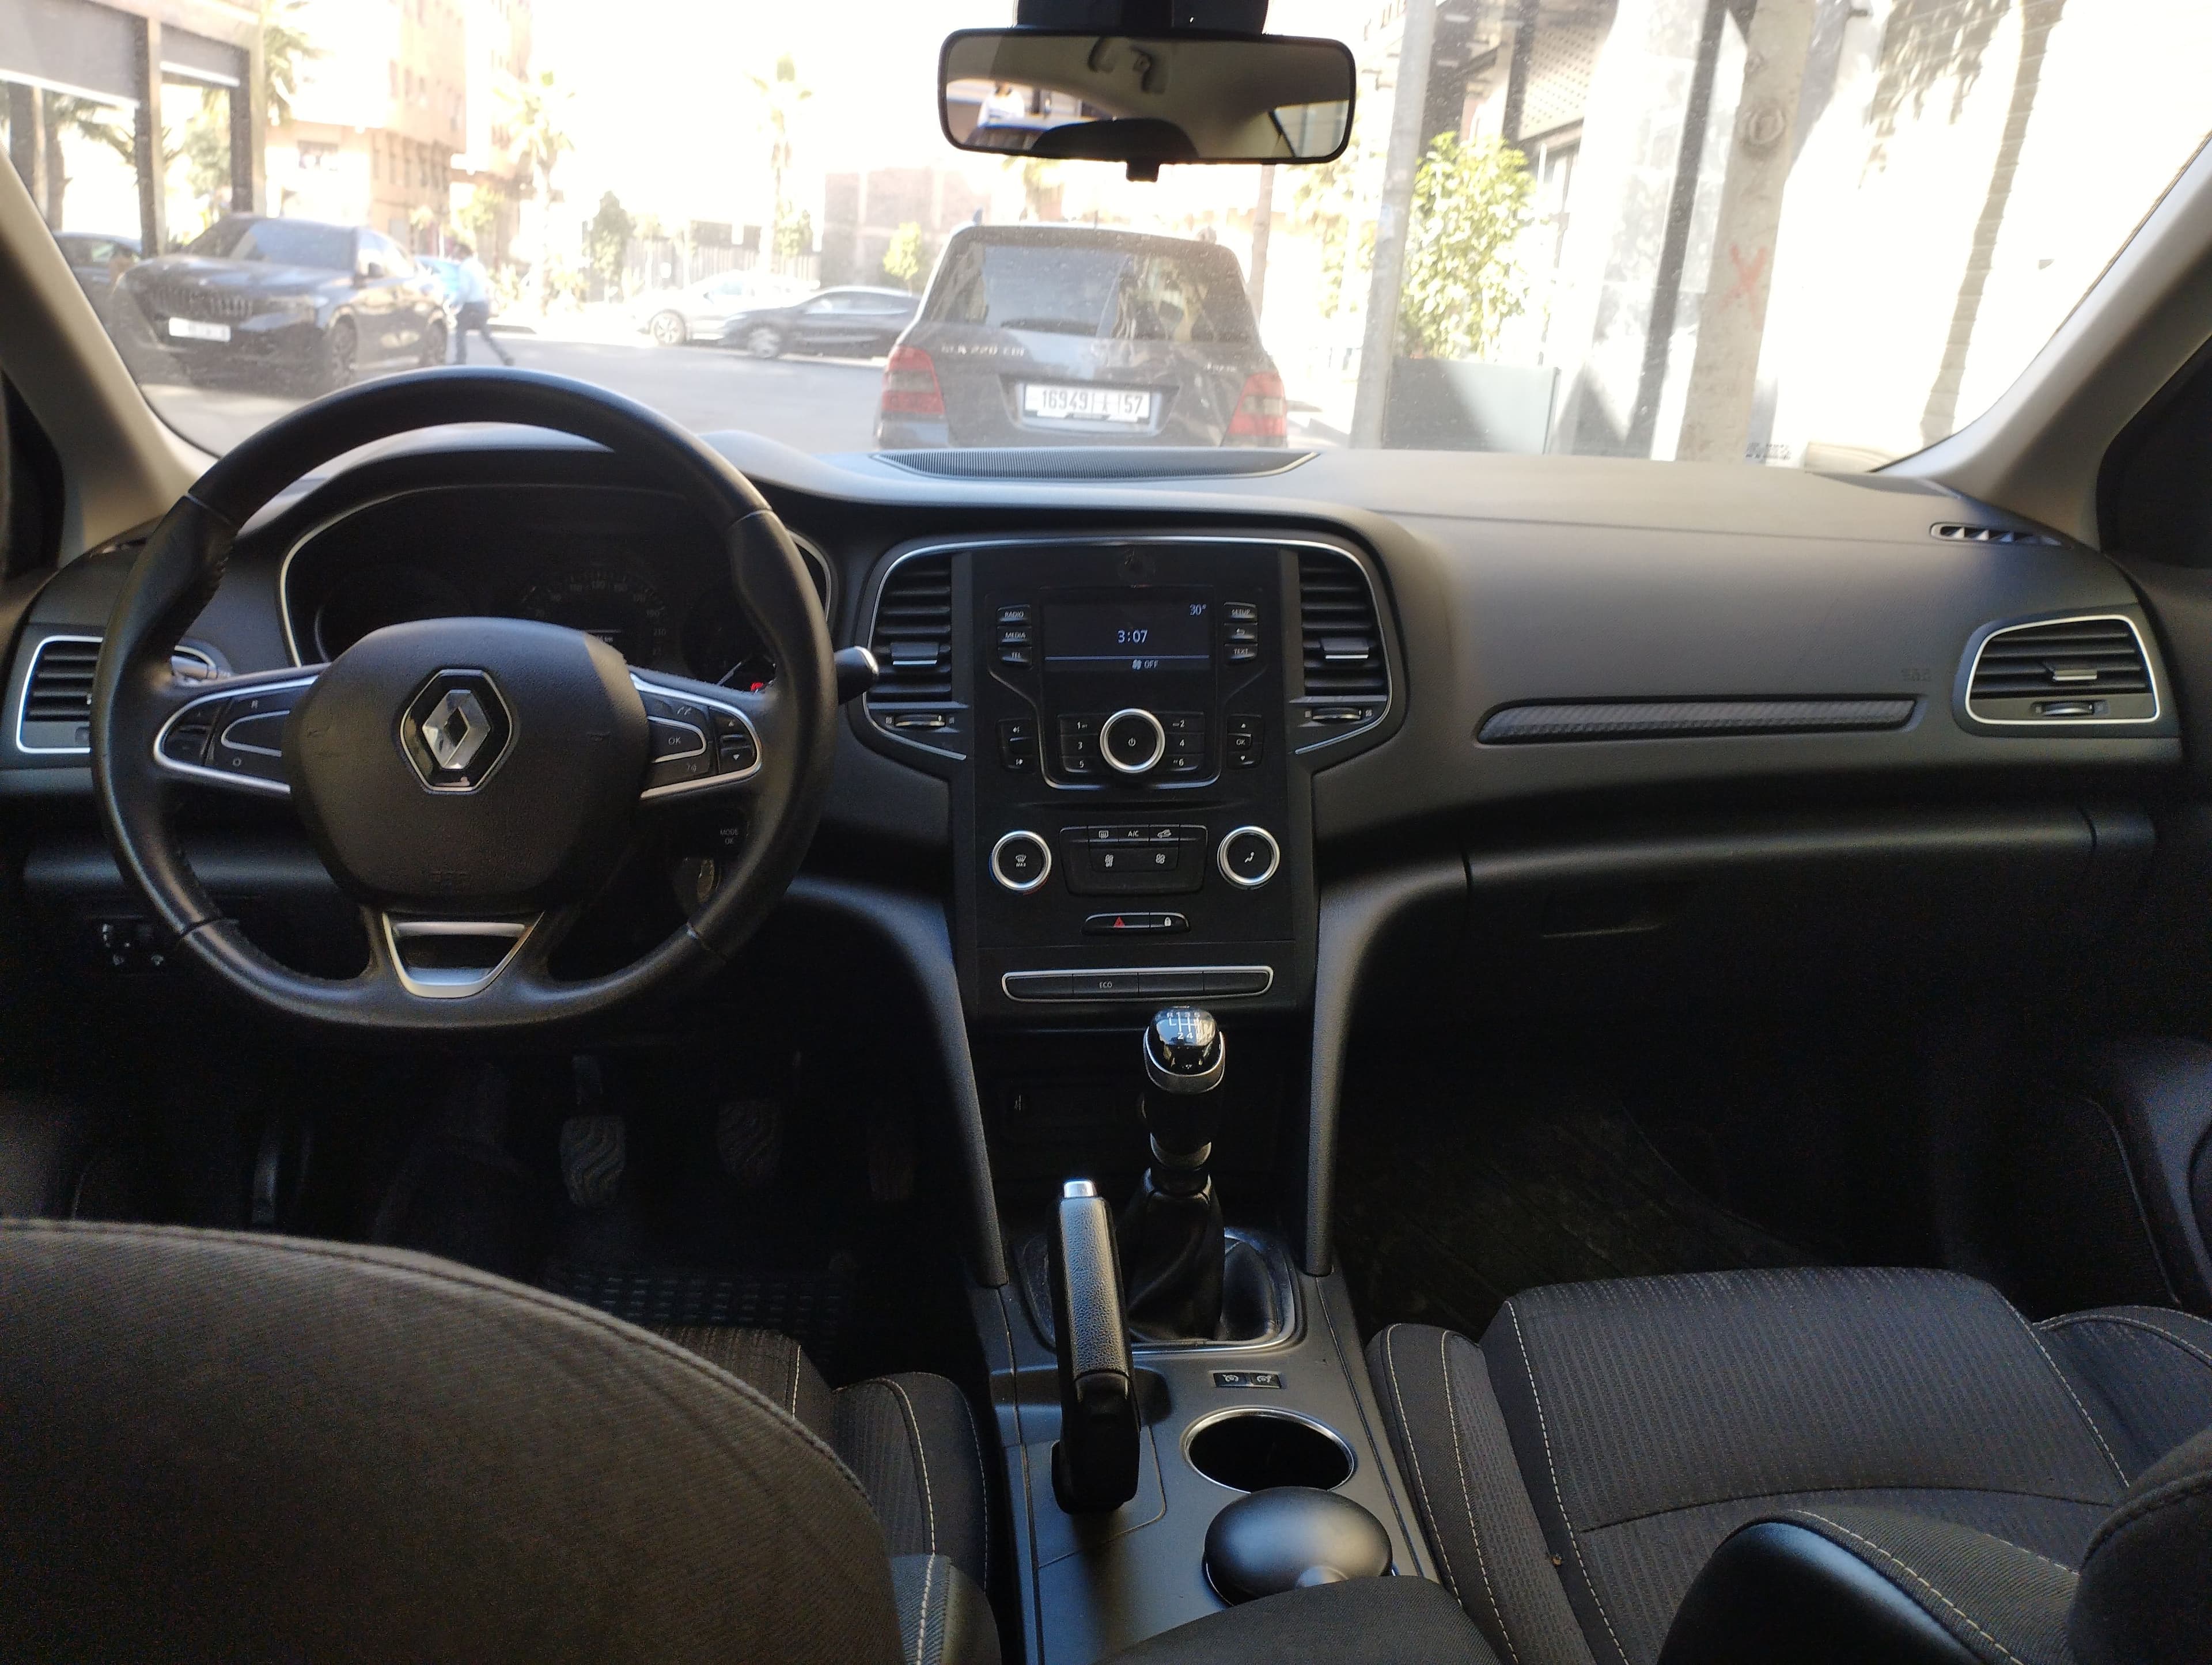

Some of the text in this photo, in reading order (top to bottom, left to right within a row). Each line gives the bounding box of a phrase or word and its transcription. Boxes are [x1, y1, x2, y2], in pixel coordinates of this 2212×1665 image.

[1041, 389, 1089, 411] 16949
[1124, 395, 1143, 415] 57
[1117, 629, 1148, 643] 3:07
[1144, 660, 1158, 669] OFF
[1180, 719, 1185, 728] 2
[668, 736, 682, 746] OK
[1078, 741, 1083, 750] 3
[1179, 739, 1185, 747] 4
[1079, 760, 1085, 768] 5
[1179, 758, 1184, 767] 6
[1177, 1031, 1184, 1040] 2
